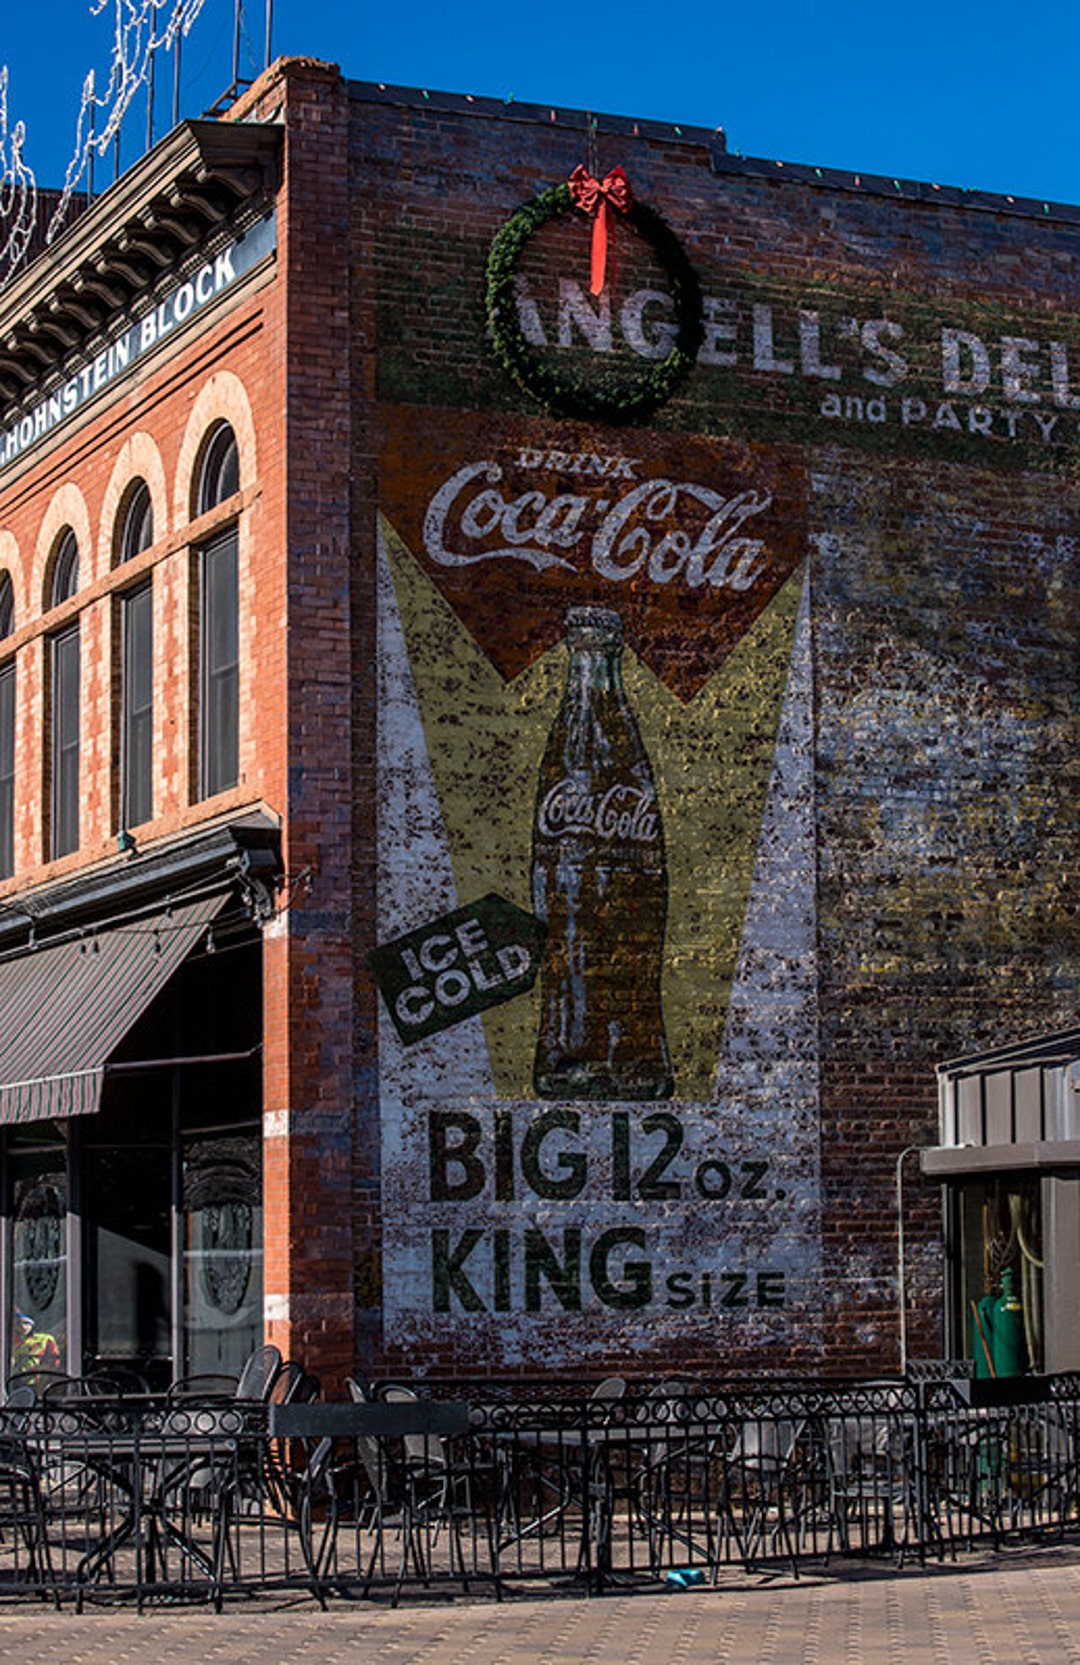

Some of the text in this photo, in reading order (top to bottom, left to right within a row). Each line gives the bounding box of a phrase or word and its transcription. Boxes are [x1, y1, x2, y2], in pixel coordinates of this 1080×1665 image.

[6, 247, 236, 459] HOHNSTEIN BLOCK
[820, 393, 887, 423] and
[902, 396, 1058, 442] PARTY
[514, 447, 643, 480] DRINK
[395, 944, 531, 1024] COLD
[400, 918, 489, 981] ICE
[428, 1108, 588, 1201] BIG
[611, 1111, 684, 1201] 12
[432, 1226, 653, 1313] KING
